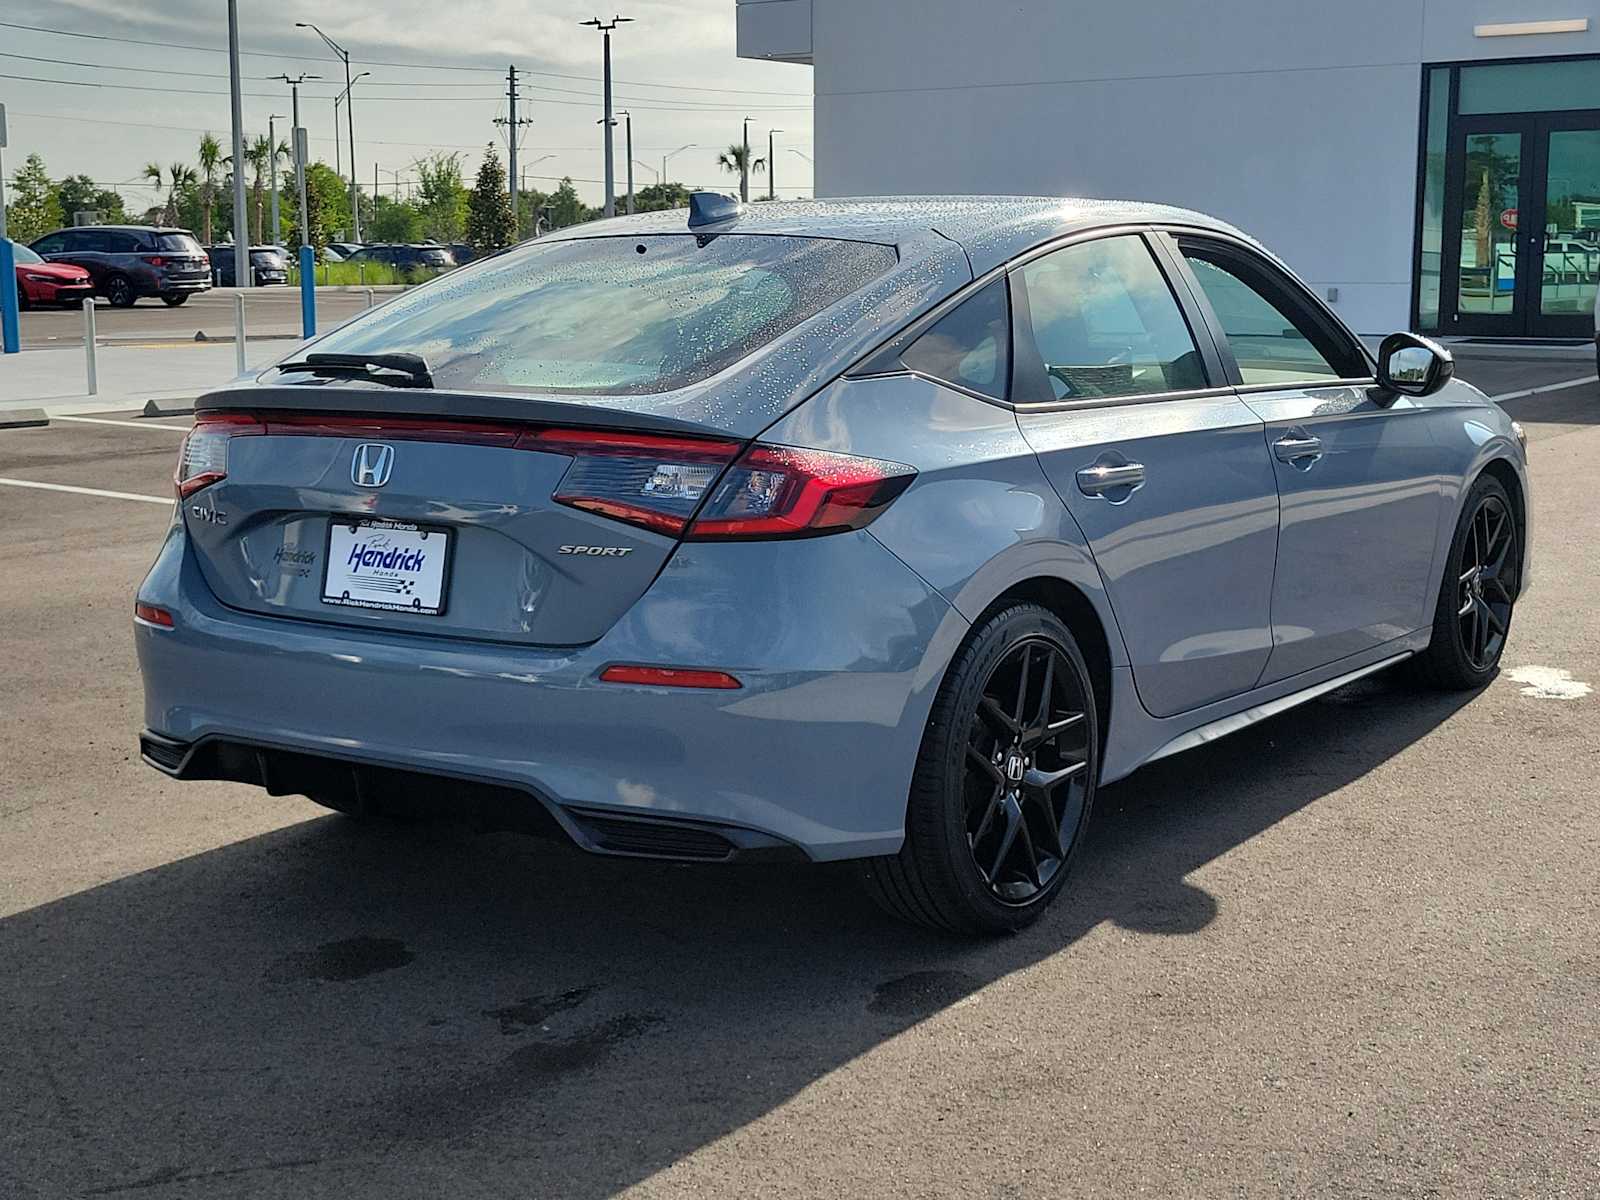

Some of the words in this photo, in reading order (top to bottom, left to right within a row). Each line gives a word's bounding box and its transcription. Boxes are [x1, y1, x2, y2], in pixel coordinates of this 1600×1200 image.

[192, 506, 227, 525] CIVIC
[393, 523, 418, 531] Honda
[347, 543, 425, 573] Hendrick
[558, 545, 633, 557] SPORT
[372, 569, 398, 577] Honda
[322, 597, 438, 615] www.RickHendrickHonda.com
